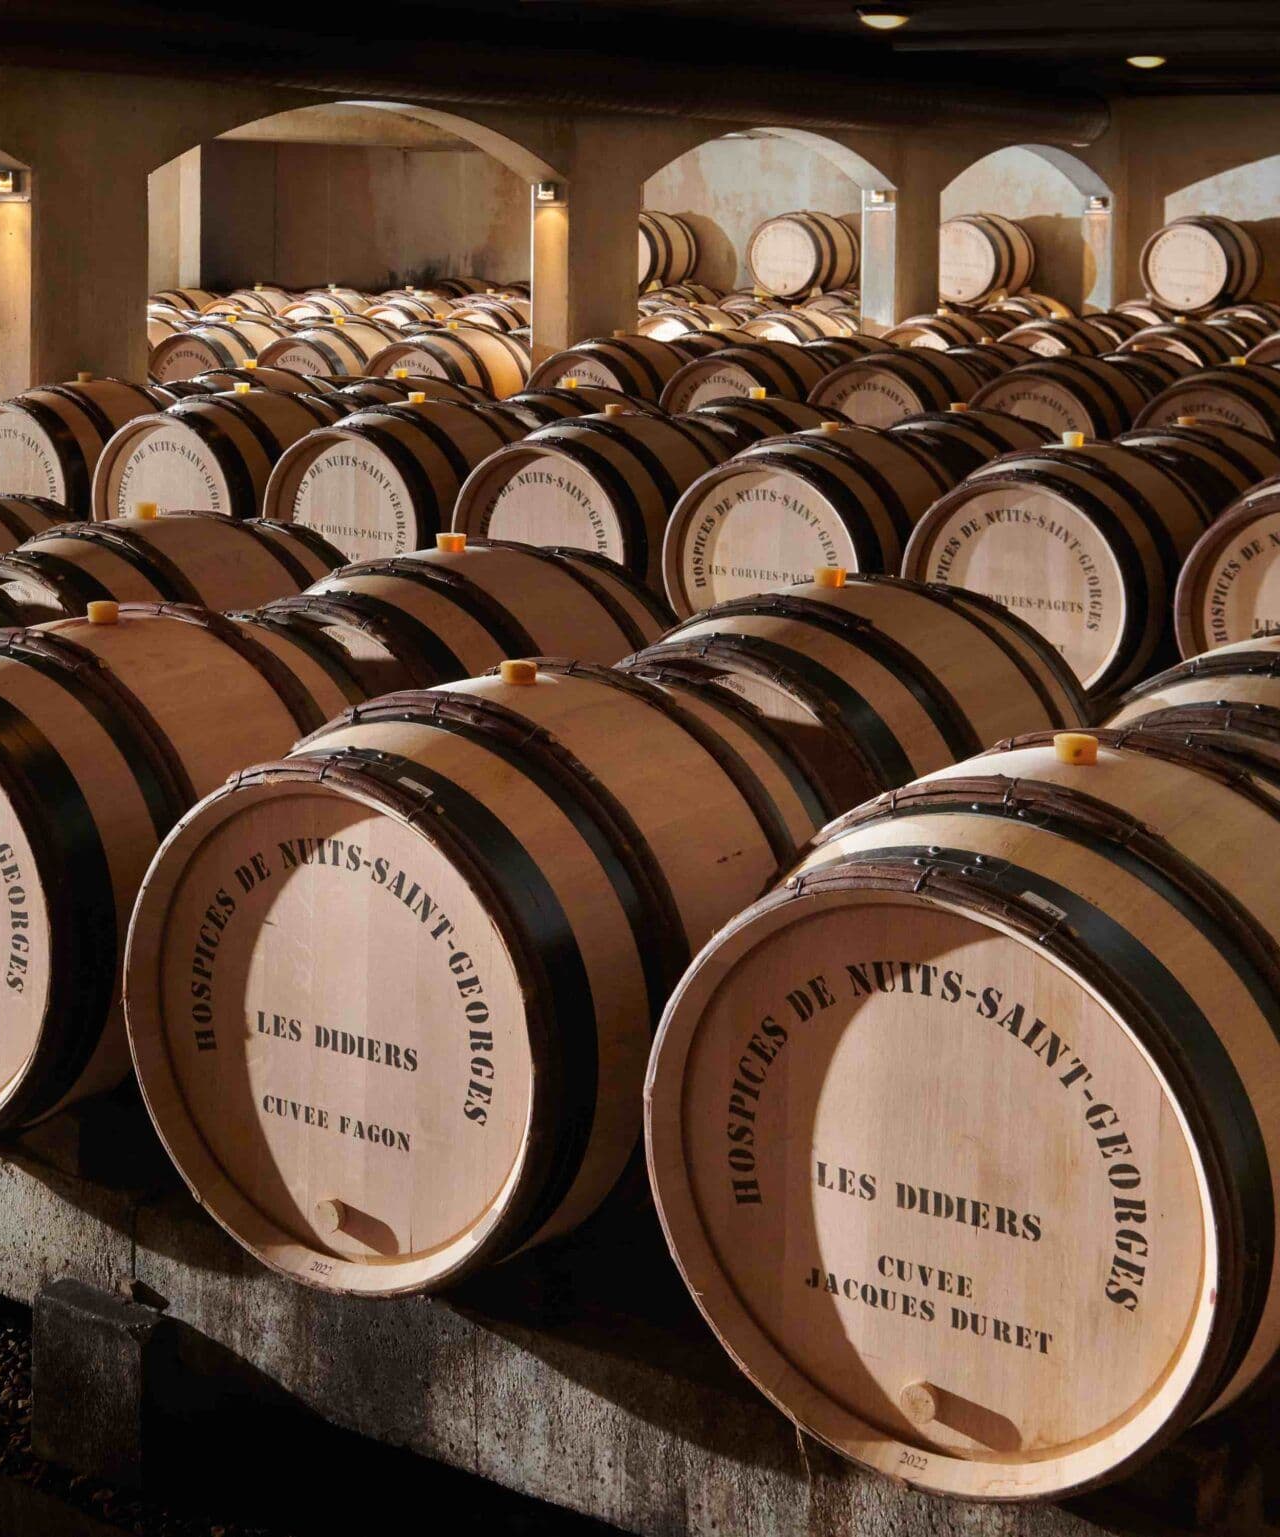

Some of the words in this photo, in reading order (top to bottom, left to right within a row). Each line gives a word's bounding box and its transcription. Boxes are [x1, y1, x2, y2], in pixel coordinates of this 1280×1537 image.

[148, 440, 220, 510] NUITS-SAINT-GEOR
[310, 464, 323, 479] DE
[498, 483, 514, 500] DE
[517, 471, 608, 556] NUITS-SAINT-GEOR
[693, 515, 716, 588] HOSPICES
[714, 498, 733, 516] DE
[736, 488, 838, 568] NUITS-SAINT-GEO
[708, 564, 728, 576] LES
[732, 566, 815, 586] CORVEES-PAGE
[936, 536, 961, 586] PICES
[960, 518, 981, 538] DE
[984, 508, 1103, 632] NUITS-SAINT-GEORGES
[980, 592, 1084, 614] ORVEES-PAGETS
[1211, 559, 1241, 642] HOSPICES
[1240, 538, 1264, 561] DE
[190, 888, 238, 1052] HOSPICES
[234, 852, 272, 894] DE
[276, 836, 497, 1127] NUITS-SAINT-GEORGES
[256, 1010, 302, 1042] LES
[314, 1024, 419, 1073] DIDIERS
[262, 1094, 330, 1131] CUVEE
[339, 1115, 412, 1154] FAGON
[727, 1015, 790, 1207] HOSPICES
[786, 974, 836, 1023] DE
[845, 960, 1150, 1314] NUITS-SAINT-GEORGES
[816, 1160, 877, 1203] LES
[896, 1180, 1043, 1244] DIDIERS
[310, 1260, 333, 1278] 2022
[877, 1254, 974, 1300] CUVEE
[804, 1267, 936, 1323] JACQUES
[950, 1308, 1053, 1356] DURET
[898, 1450, 930, 1472] 2022
